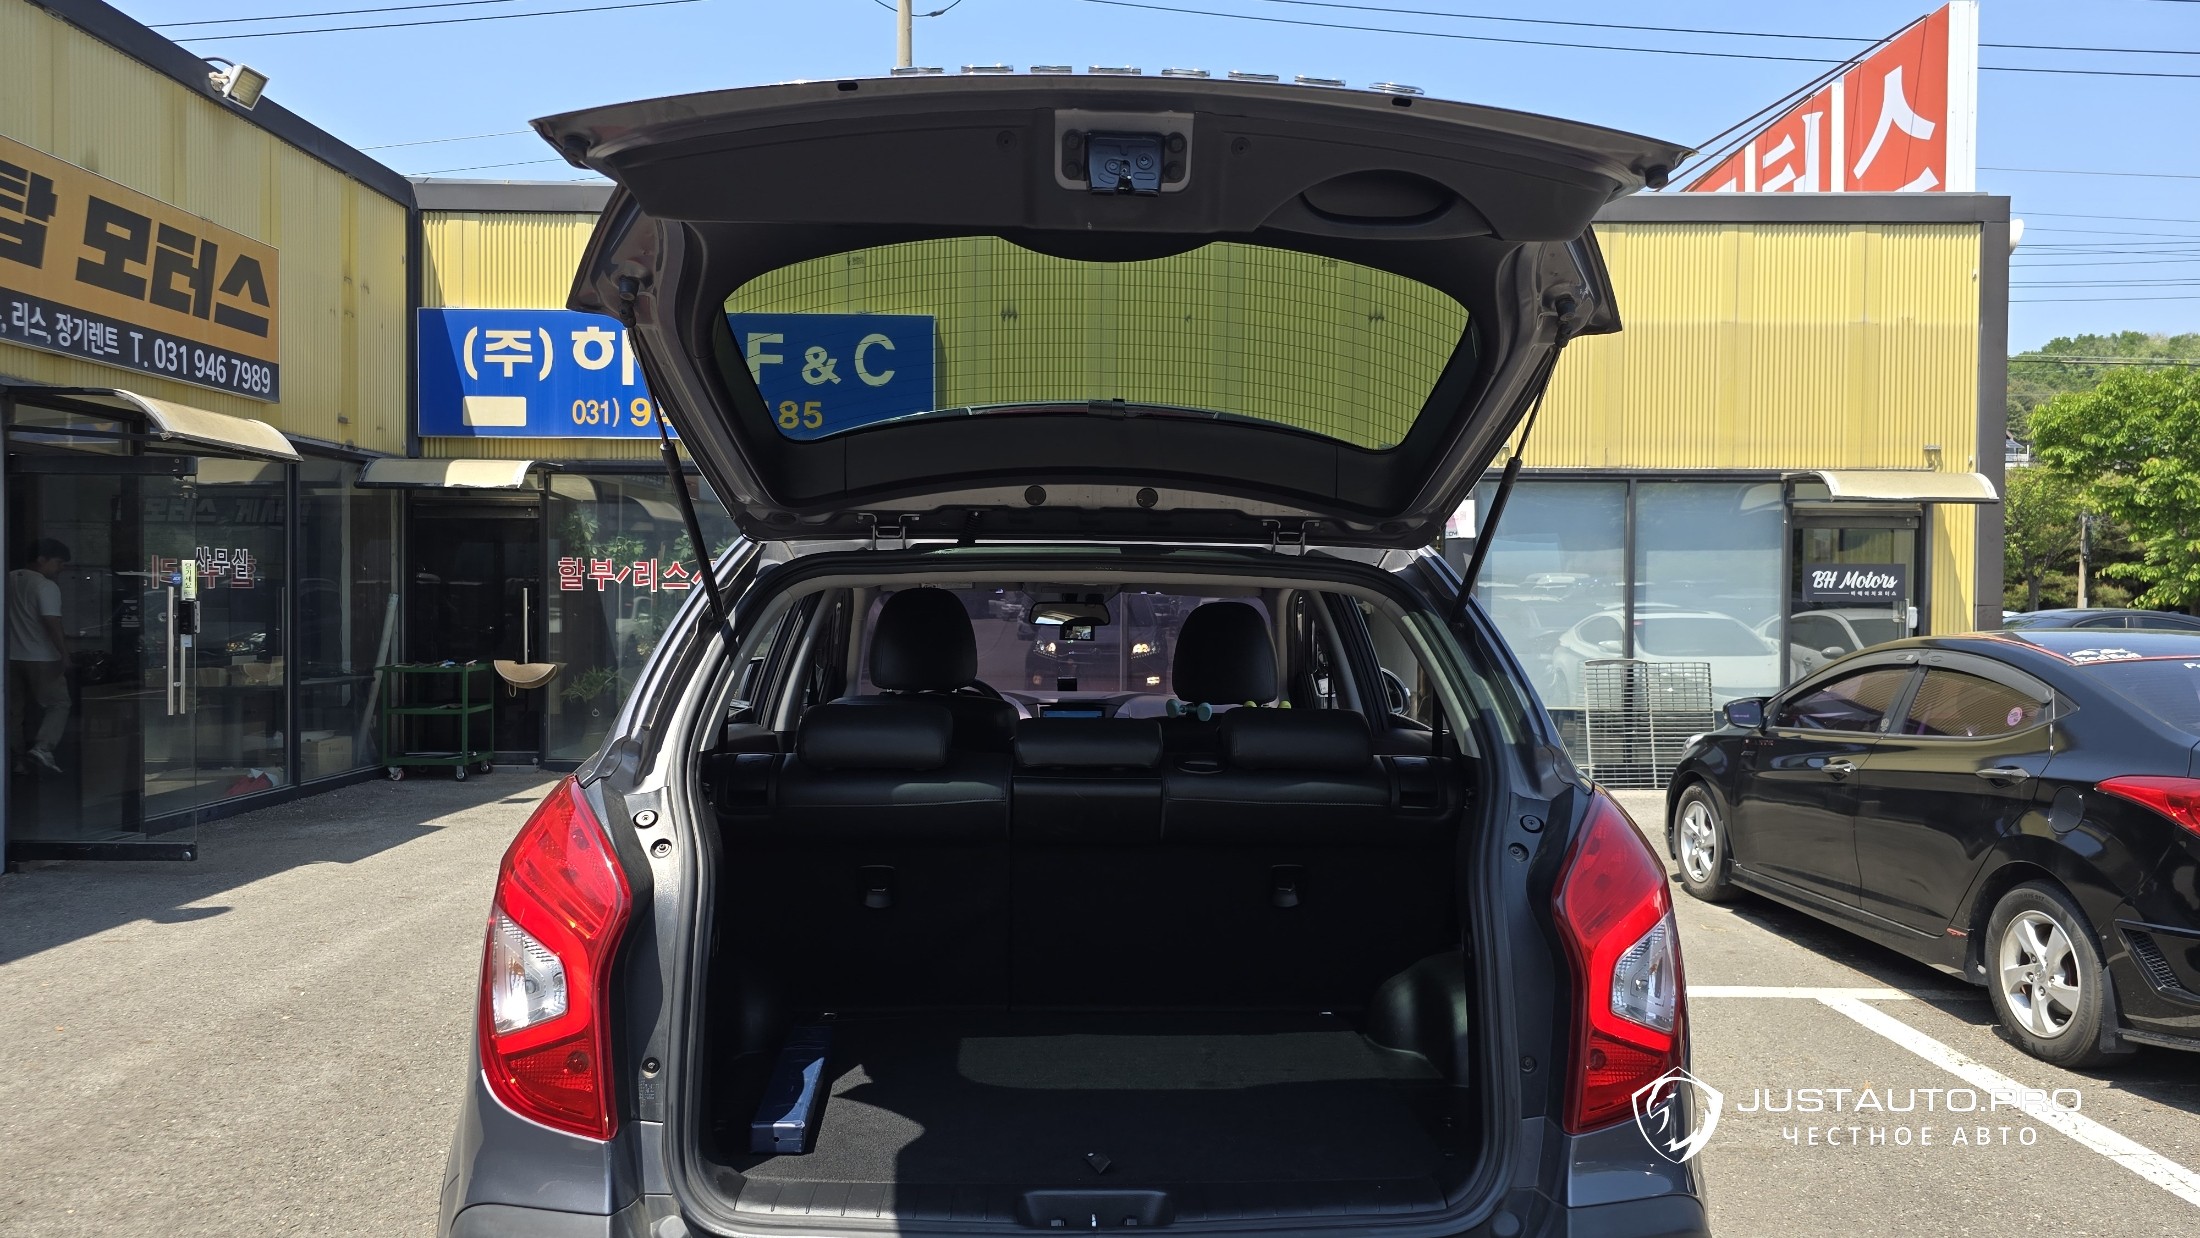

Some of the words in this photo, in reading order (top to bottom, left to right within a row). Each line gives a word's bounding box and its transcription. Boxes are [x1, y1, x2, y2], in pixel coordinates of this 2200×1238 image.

[75, 194, 271, 338] 모터스
[12, 301, 51, 344] 리스,
[56, 313, 120, 355] 장기렌트
[130, 331, 149, 368] T.
[154, 338, 188, 375] 031
[194, 349, 227, 384] 946
[231, 359, 271, 394] 7989
[463, 326, 554, 382] (주)
[746, 332, 784, 385] F
[801, 345, 842, 386] &
[854, 332, 896, 387] C
[572, 397, 620, 427] 031)
[196, 546, 249, 580] 사무실
[557, 556, 718, 593] 할부/리스/
[1811, 570, 1838, 589] BH
[1838, 570, 1898, 589] Motors
